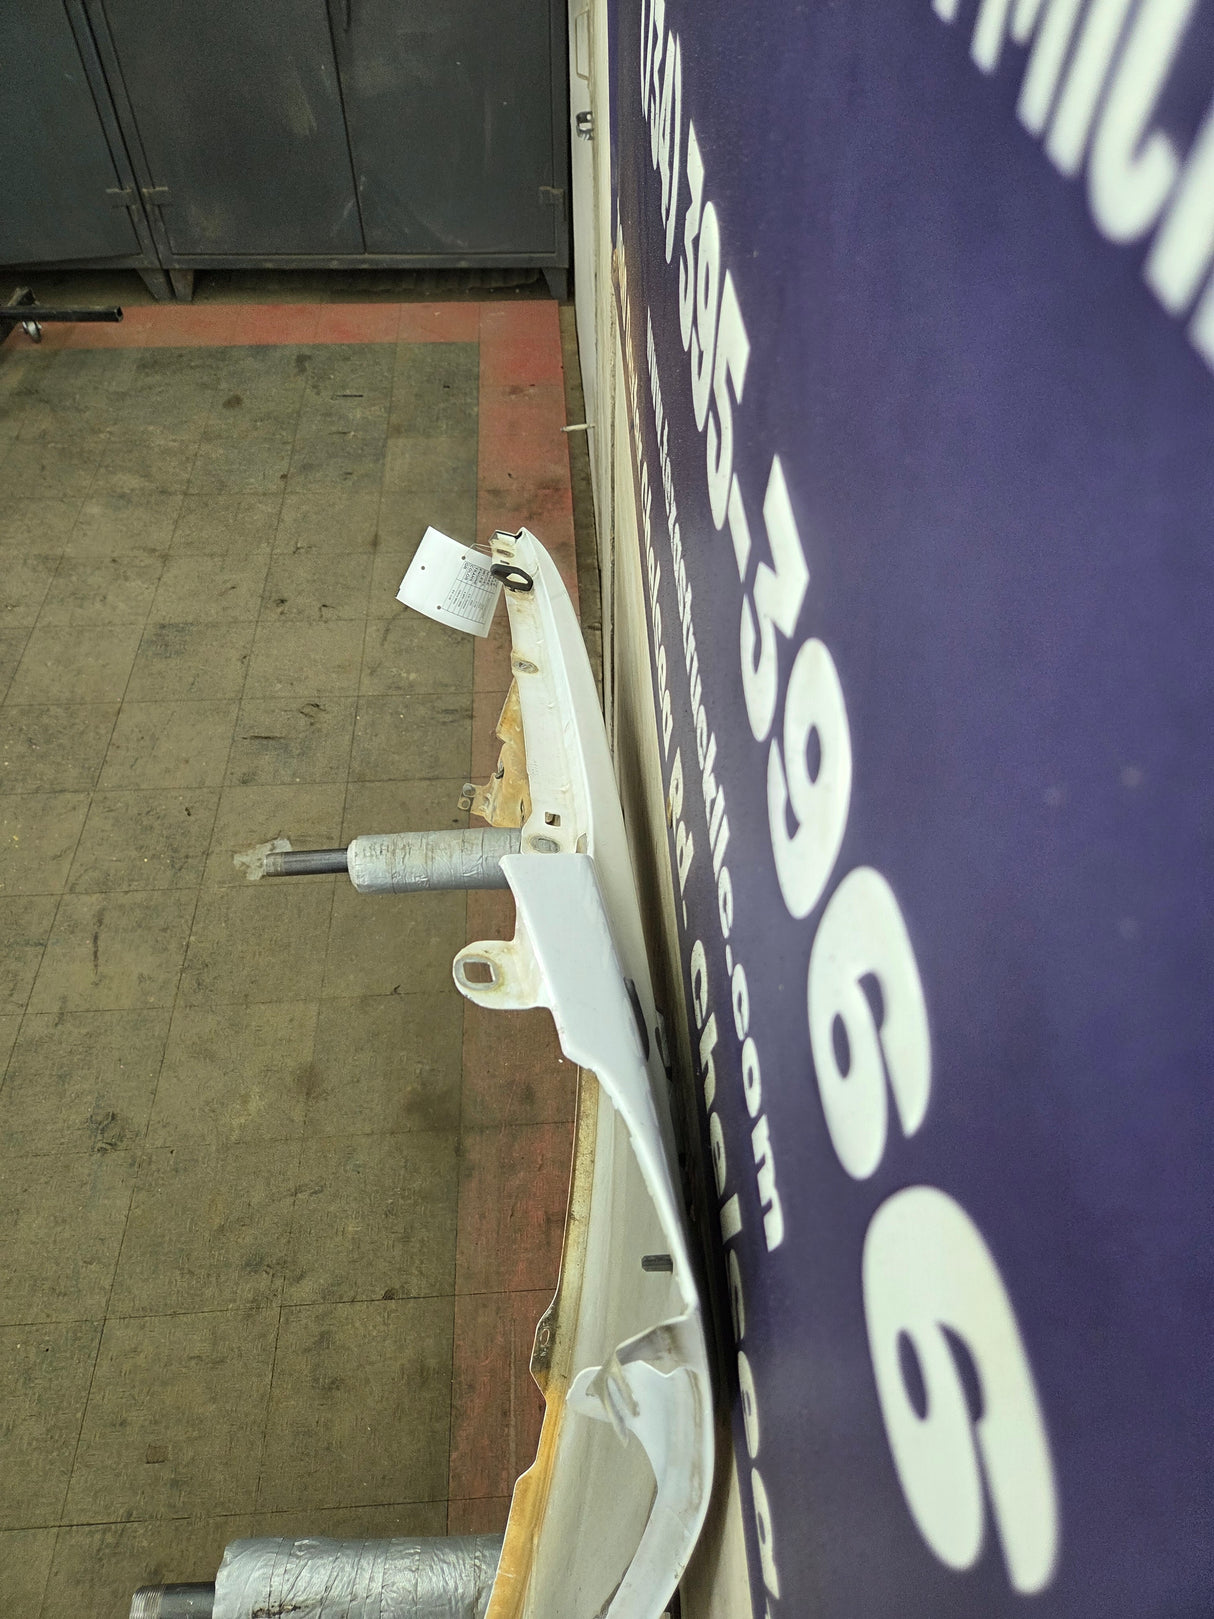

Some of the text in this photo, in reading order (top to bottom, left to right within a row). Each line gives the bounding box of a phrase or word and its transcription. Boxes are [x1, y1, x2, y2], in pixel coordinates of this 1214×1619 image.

[641, 461, 673, 763] Chelsea
[646, 305, 785, 1252] www.texastruckllc.com
[679, 117, 1059, 1594] 395-3966
